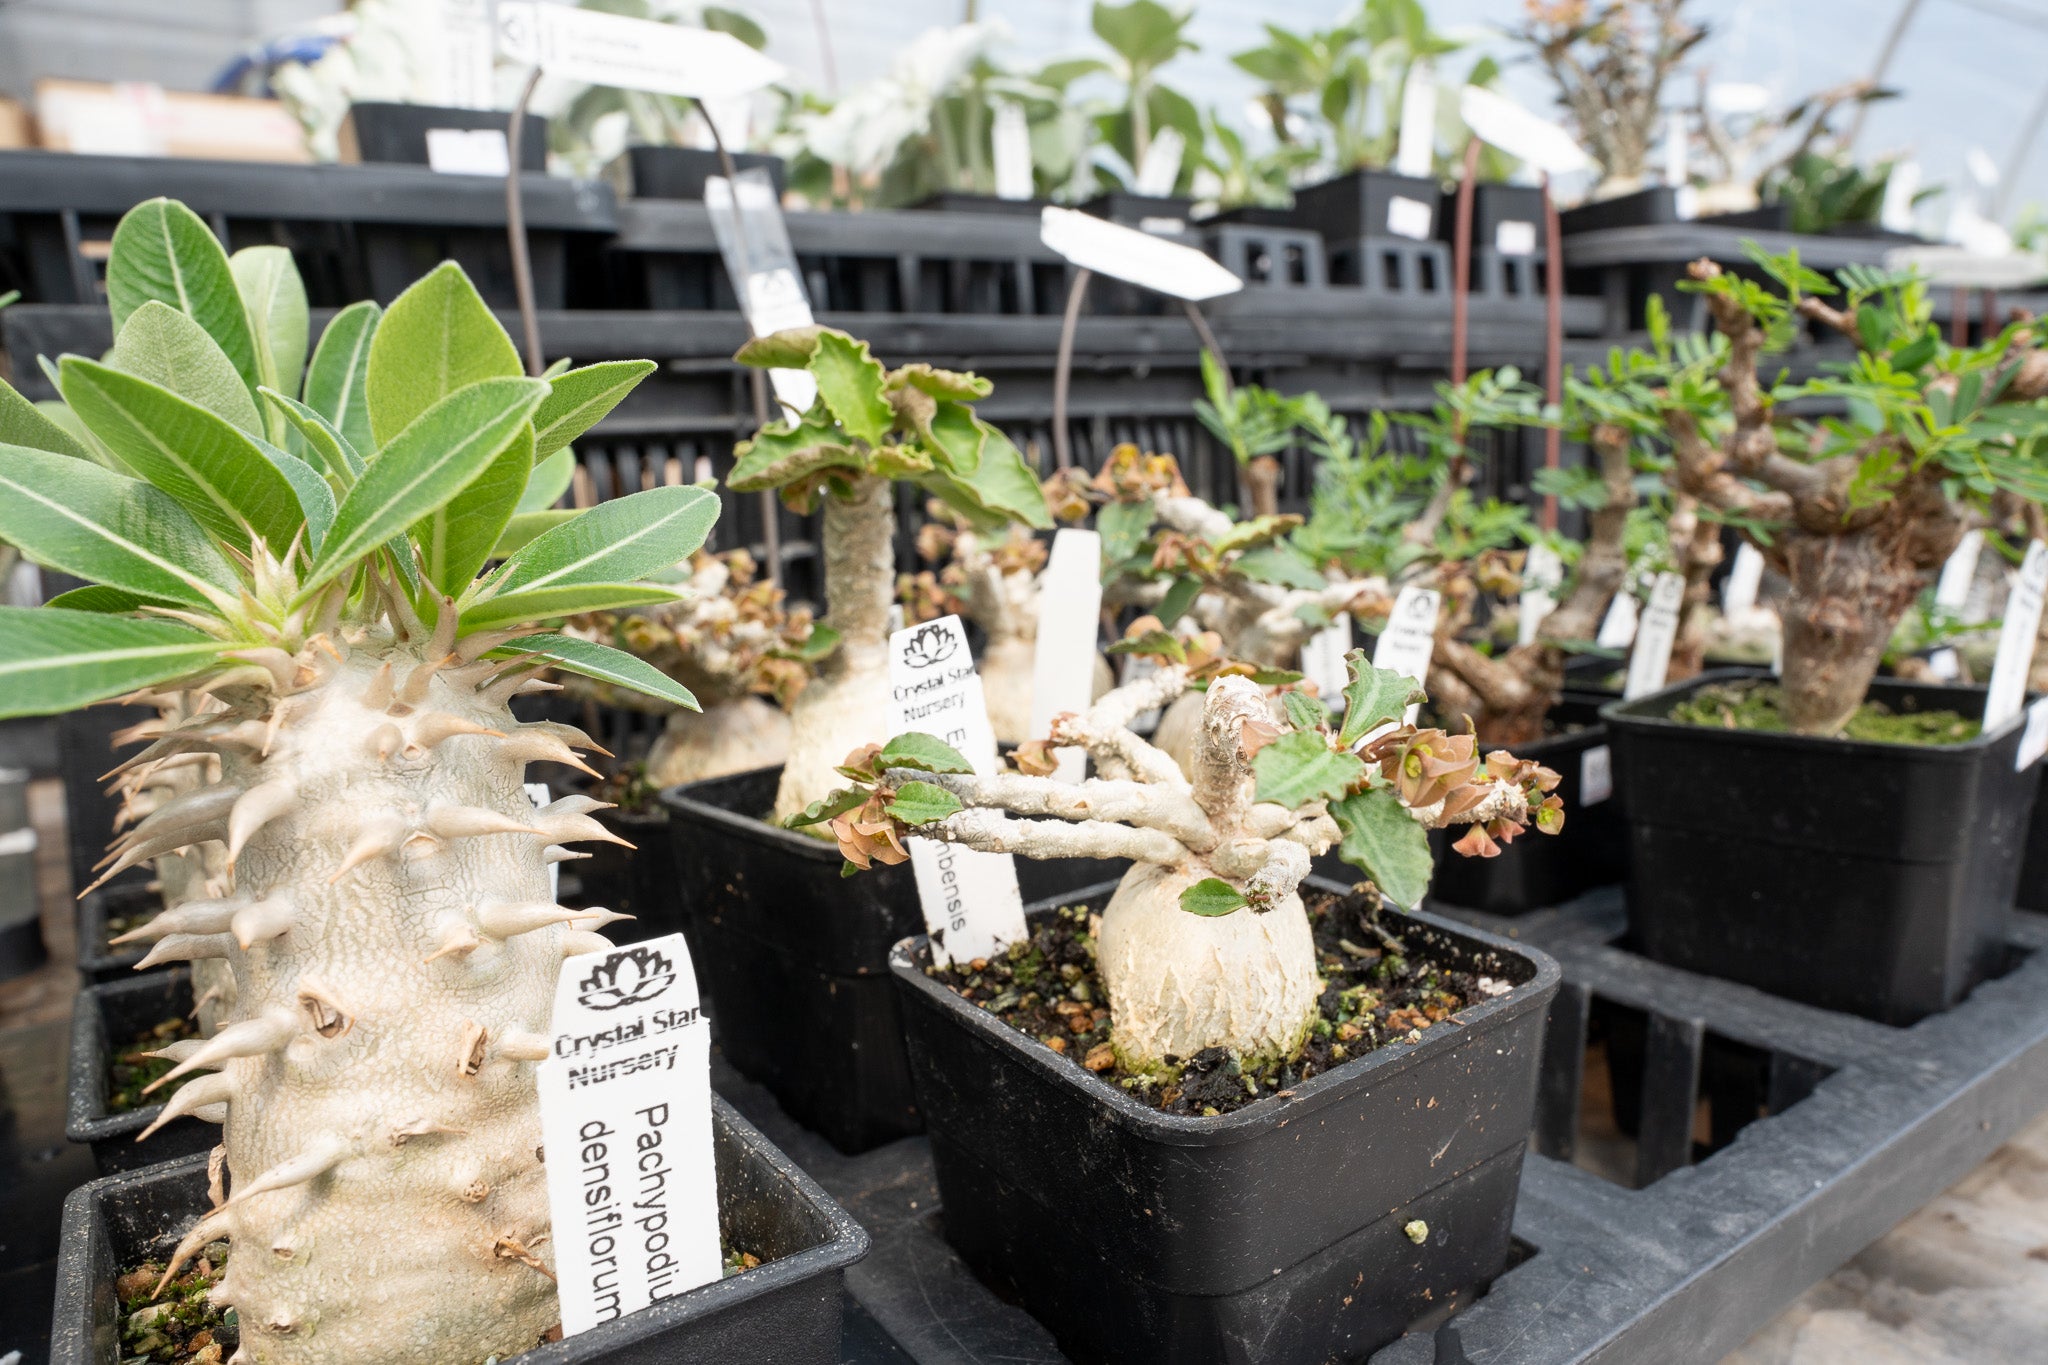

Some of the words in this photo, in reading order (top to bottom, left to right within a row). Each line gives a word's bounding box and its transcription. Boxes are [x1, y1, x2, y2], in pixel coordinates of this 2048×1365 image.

[894, 672, 944, 701] Crystal
[904, 691, 965, 722] Nursery
[555, 1015, 648, 1059] Crystal
[652, 1008, 700, 1035] Star
[568, 1044, 679, 1090] Nursery
[580, 1120, 622, 1327] densiflorum
[632, 1102, 680, 1304] Pachypodiu
